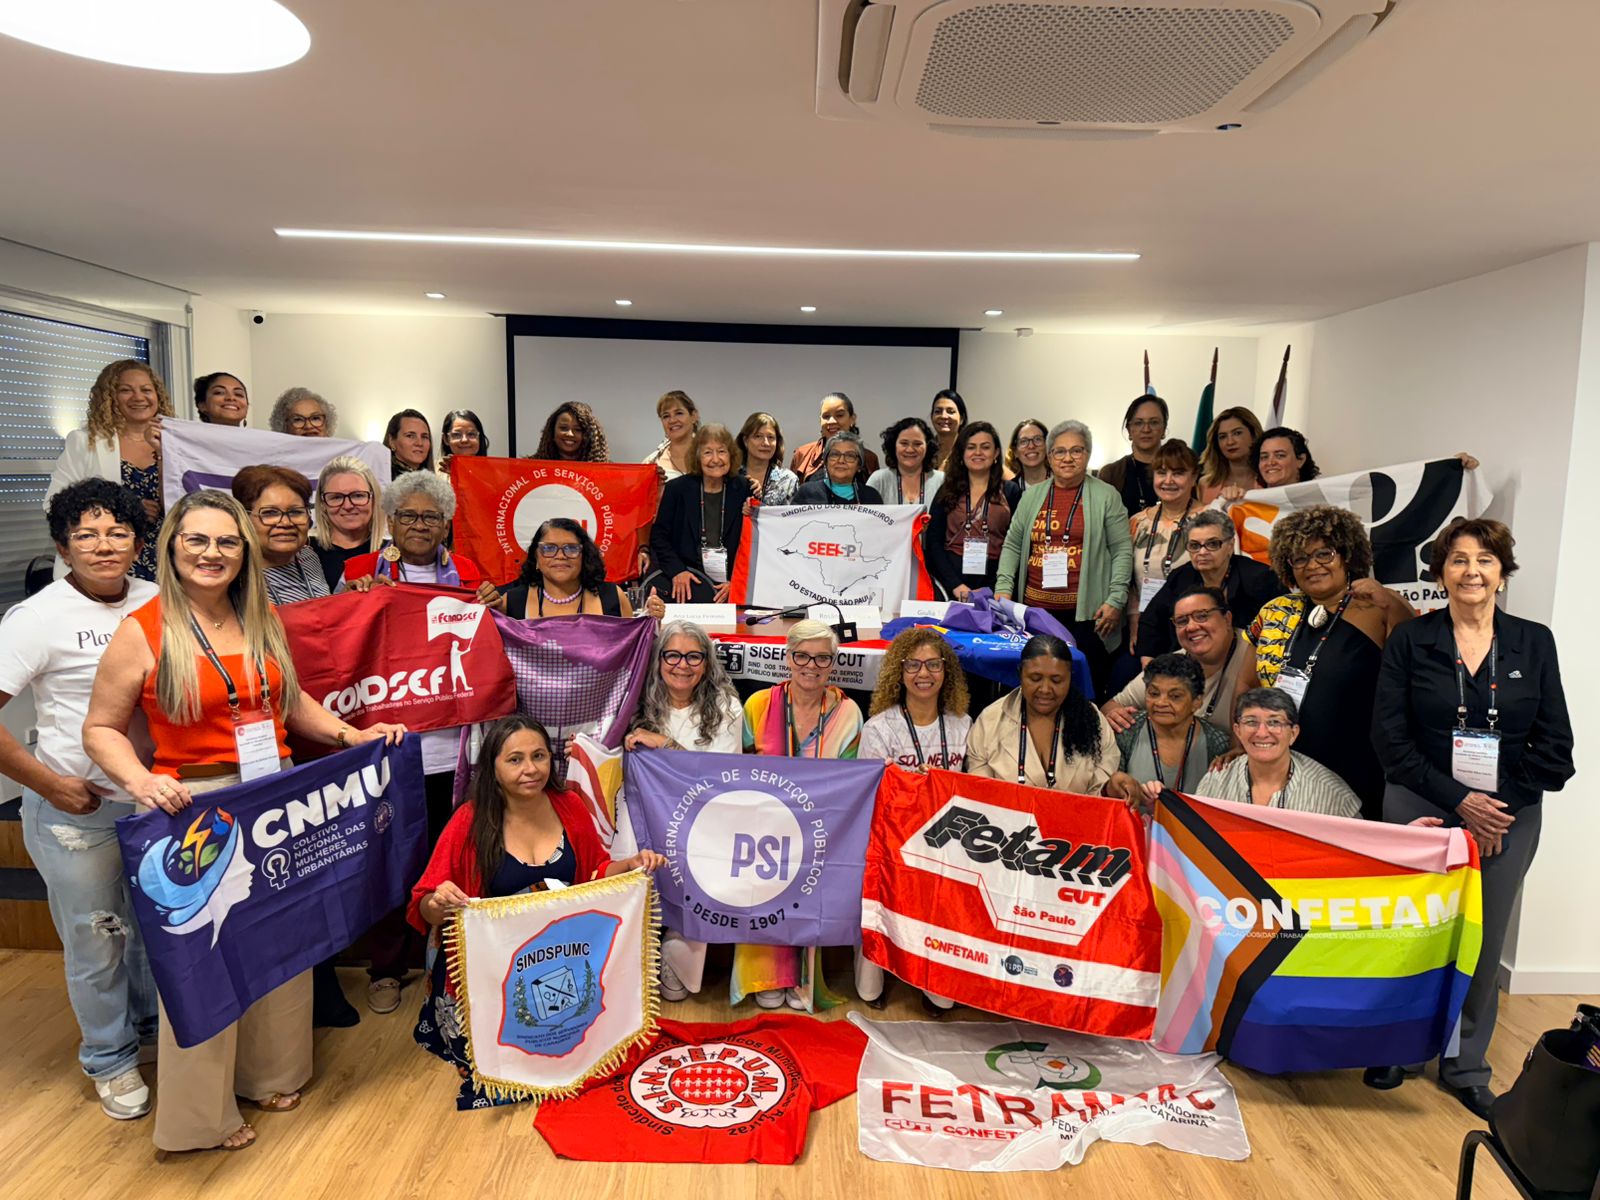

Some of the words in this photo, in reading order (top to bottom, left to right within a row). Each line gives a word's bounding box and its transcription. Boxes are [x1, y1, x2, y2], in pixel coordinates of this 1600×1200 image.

[496, 476, 530, 555] INTERNACIONAL
[533, 468, 548, 479] DE
[554, 468, 604, 501] SERVIÇOS
[601, 504, 614, 556] PÚBLICO
[781, 504, 823, 518] SINDICATO
[843, 504, 895, 526] ENFERMEIROS
[789, 580, 800, 590] DO
[800, 586, 827, 602] ESTADO
[322, 665, 447, 718] CONDSEF
[413, 697, 434, 706] Serviço
[454, 690, 474, 698] Federal
[928, 752, 963, 767] NERA
[252, 757, 391, 848] CNMU
[293, 823, 338, 850] COLETIVO
[294, 832, 344, 860] NACIONAL
[345, 821, 366, 836] DAS
[666, 780, 714, 888] INTERNACIONAL
[721, 768, 740, 783] DE
[750, 768, 815, 812] SERVIÇOS
[801, 818, 829, 896] PÚBLICOS
[923, 805, 1132, 888] Fetam
[296, 839, 348, 868] MULHERES
[297, 840, 369, 877] URBANITÁRIAS
[730, 833, 790, 881] PSI
[1057, 887, 1106, 907] CUT
[1195, 888, 1462, 930] CONFETAM
[693, 902, 739, 928] DESDE
[750, 908, 785, 930] 1907
[1013, 905, 1036, 919] São
[1039, 910, 1077, 926] Paulo
[516, 942, 590, 973] SINDSPUMC
[617, 1095, 675, 1135] Sindicato
[885, 1119, 932, 1132] CUT
[943, 1125, 1019, 1140] CONFET
[1150, 1104, 1209, 1129] CATARINA
